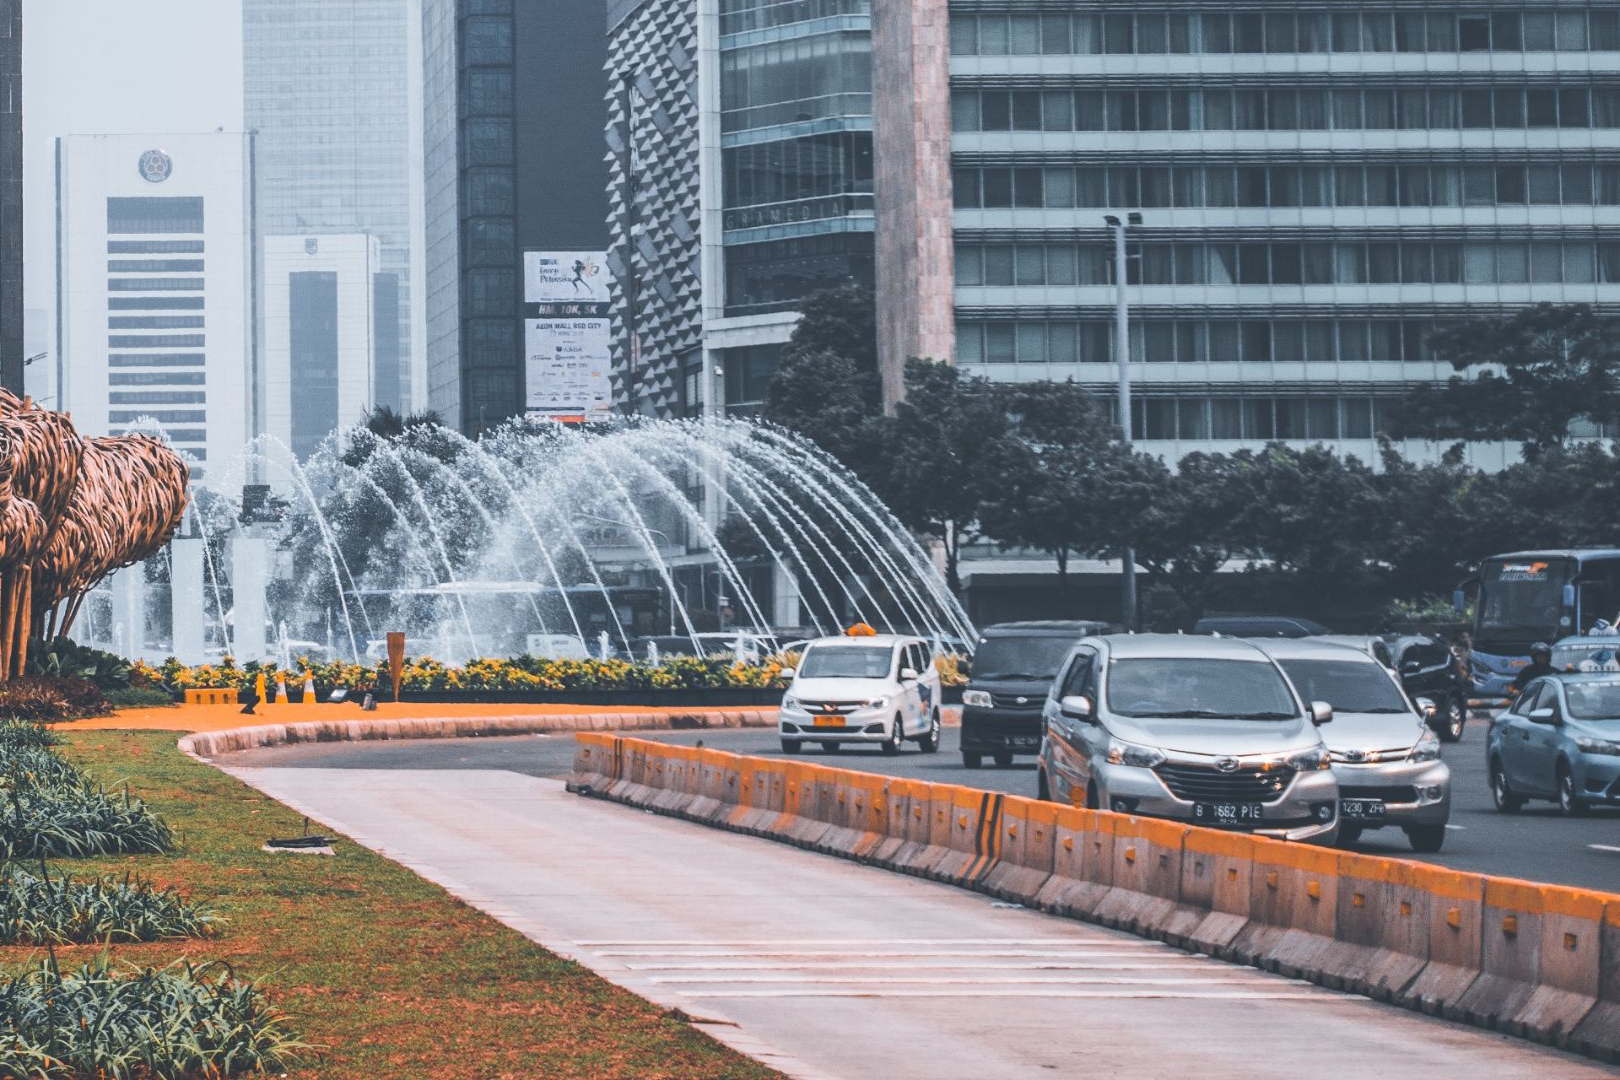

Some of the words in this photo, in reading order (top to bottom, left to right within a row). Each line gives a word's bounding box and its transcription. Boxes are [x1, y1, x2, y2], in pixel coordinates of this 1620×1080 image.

[726, 201, 839, 229] GRAMEDIA
[1241, 806, 1261, 818] PIE
[1343, 802, 1362, 813] 1230
